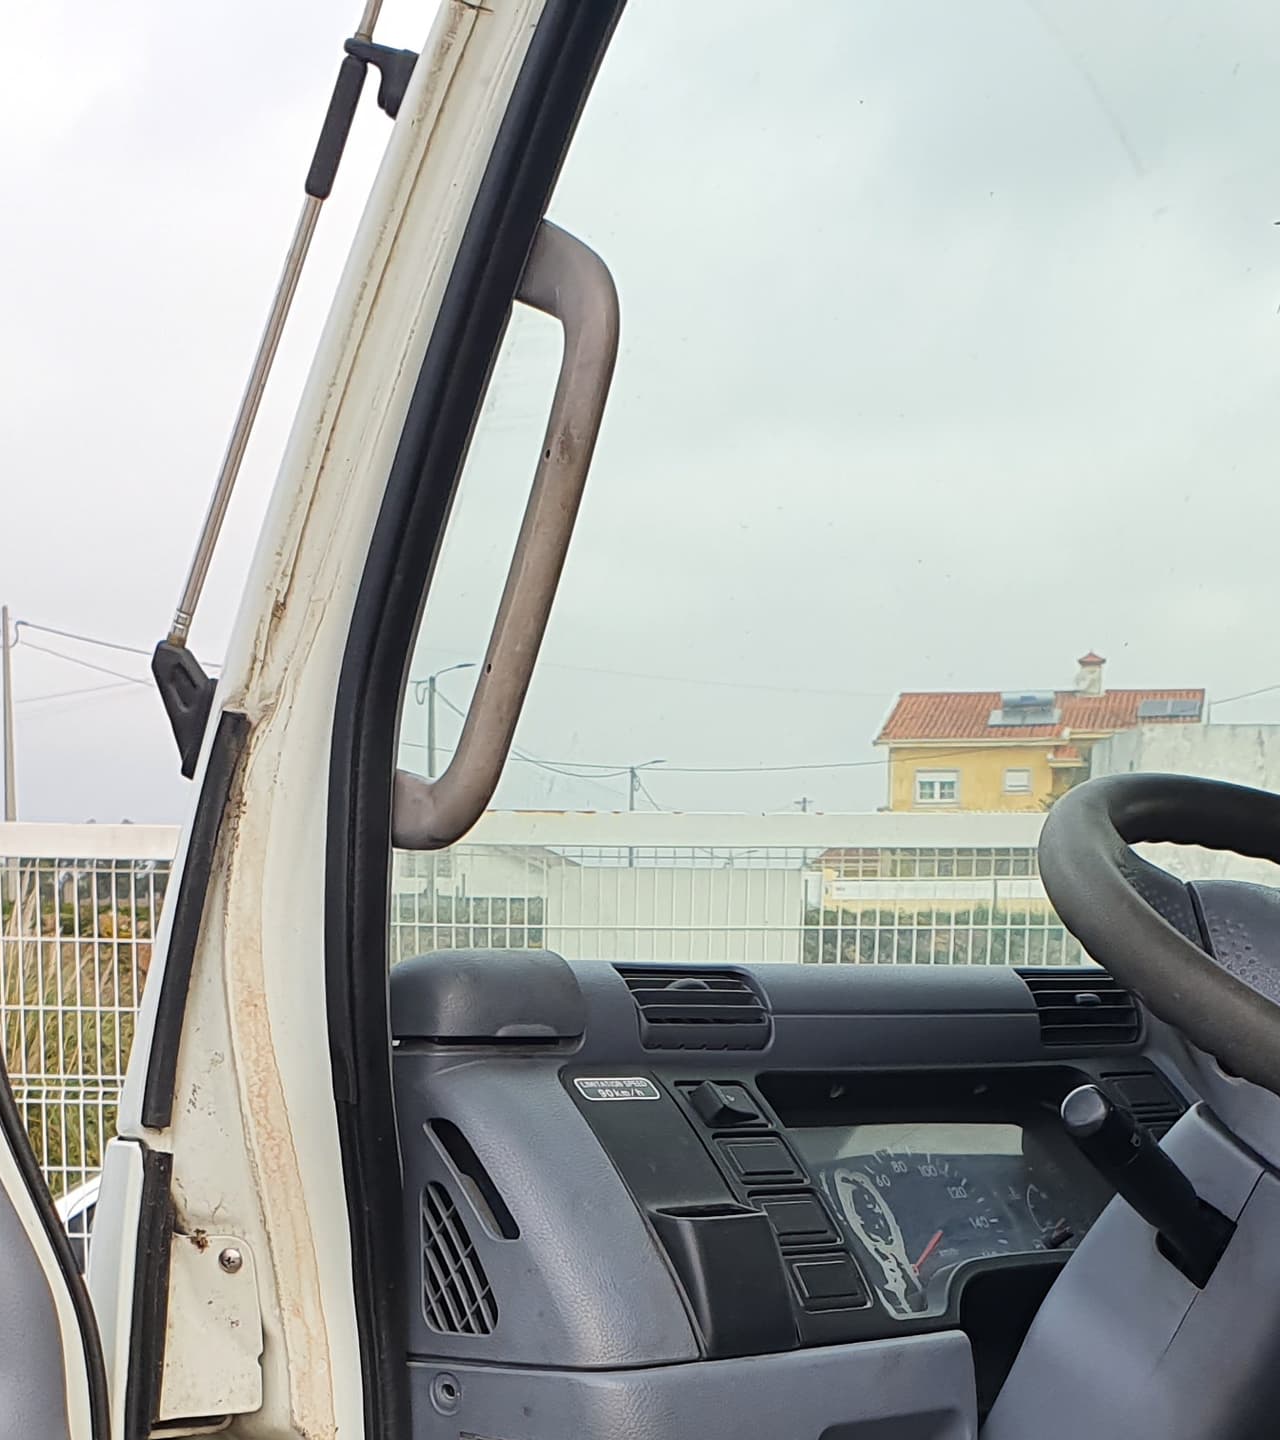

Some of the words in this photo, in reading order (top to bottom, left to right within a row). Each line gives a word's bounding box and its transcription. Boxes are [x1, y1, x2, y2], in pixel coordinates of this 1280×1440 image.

[624, 1080, 648, 1088] SPEED
[892, 1160, 907, 1173] 80
[918, 1164, 938, 1177] 100
[876, 1174, 891, 1188] 60
[946, 1186, 968, 1199] 120
[969, 1216, 990, 1229] 140
